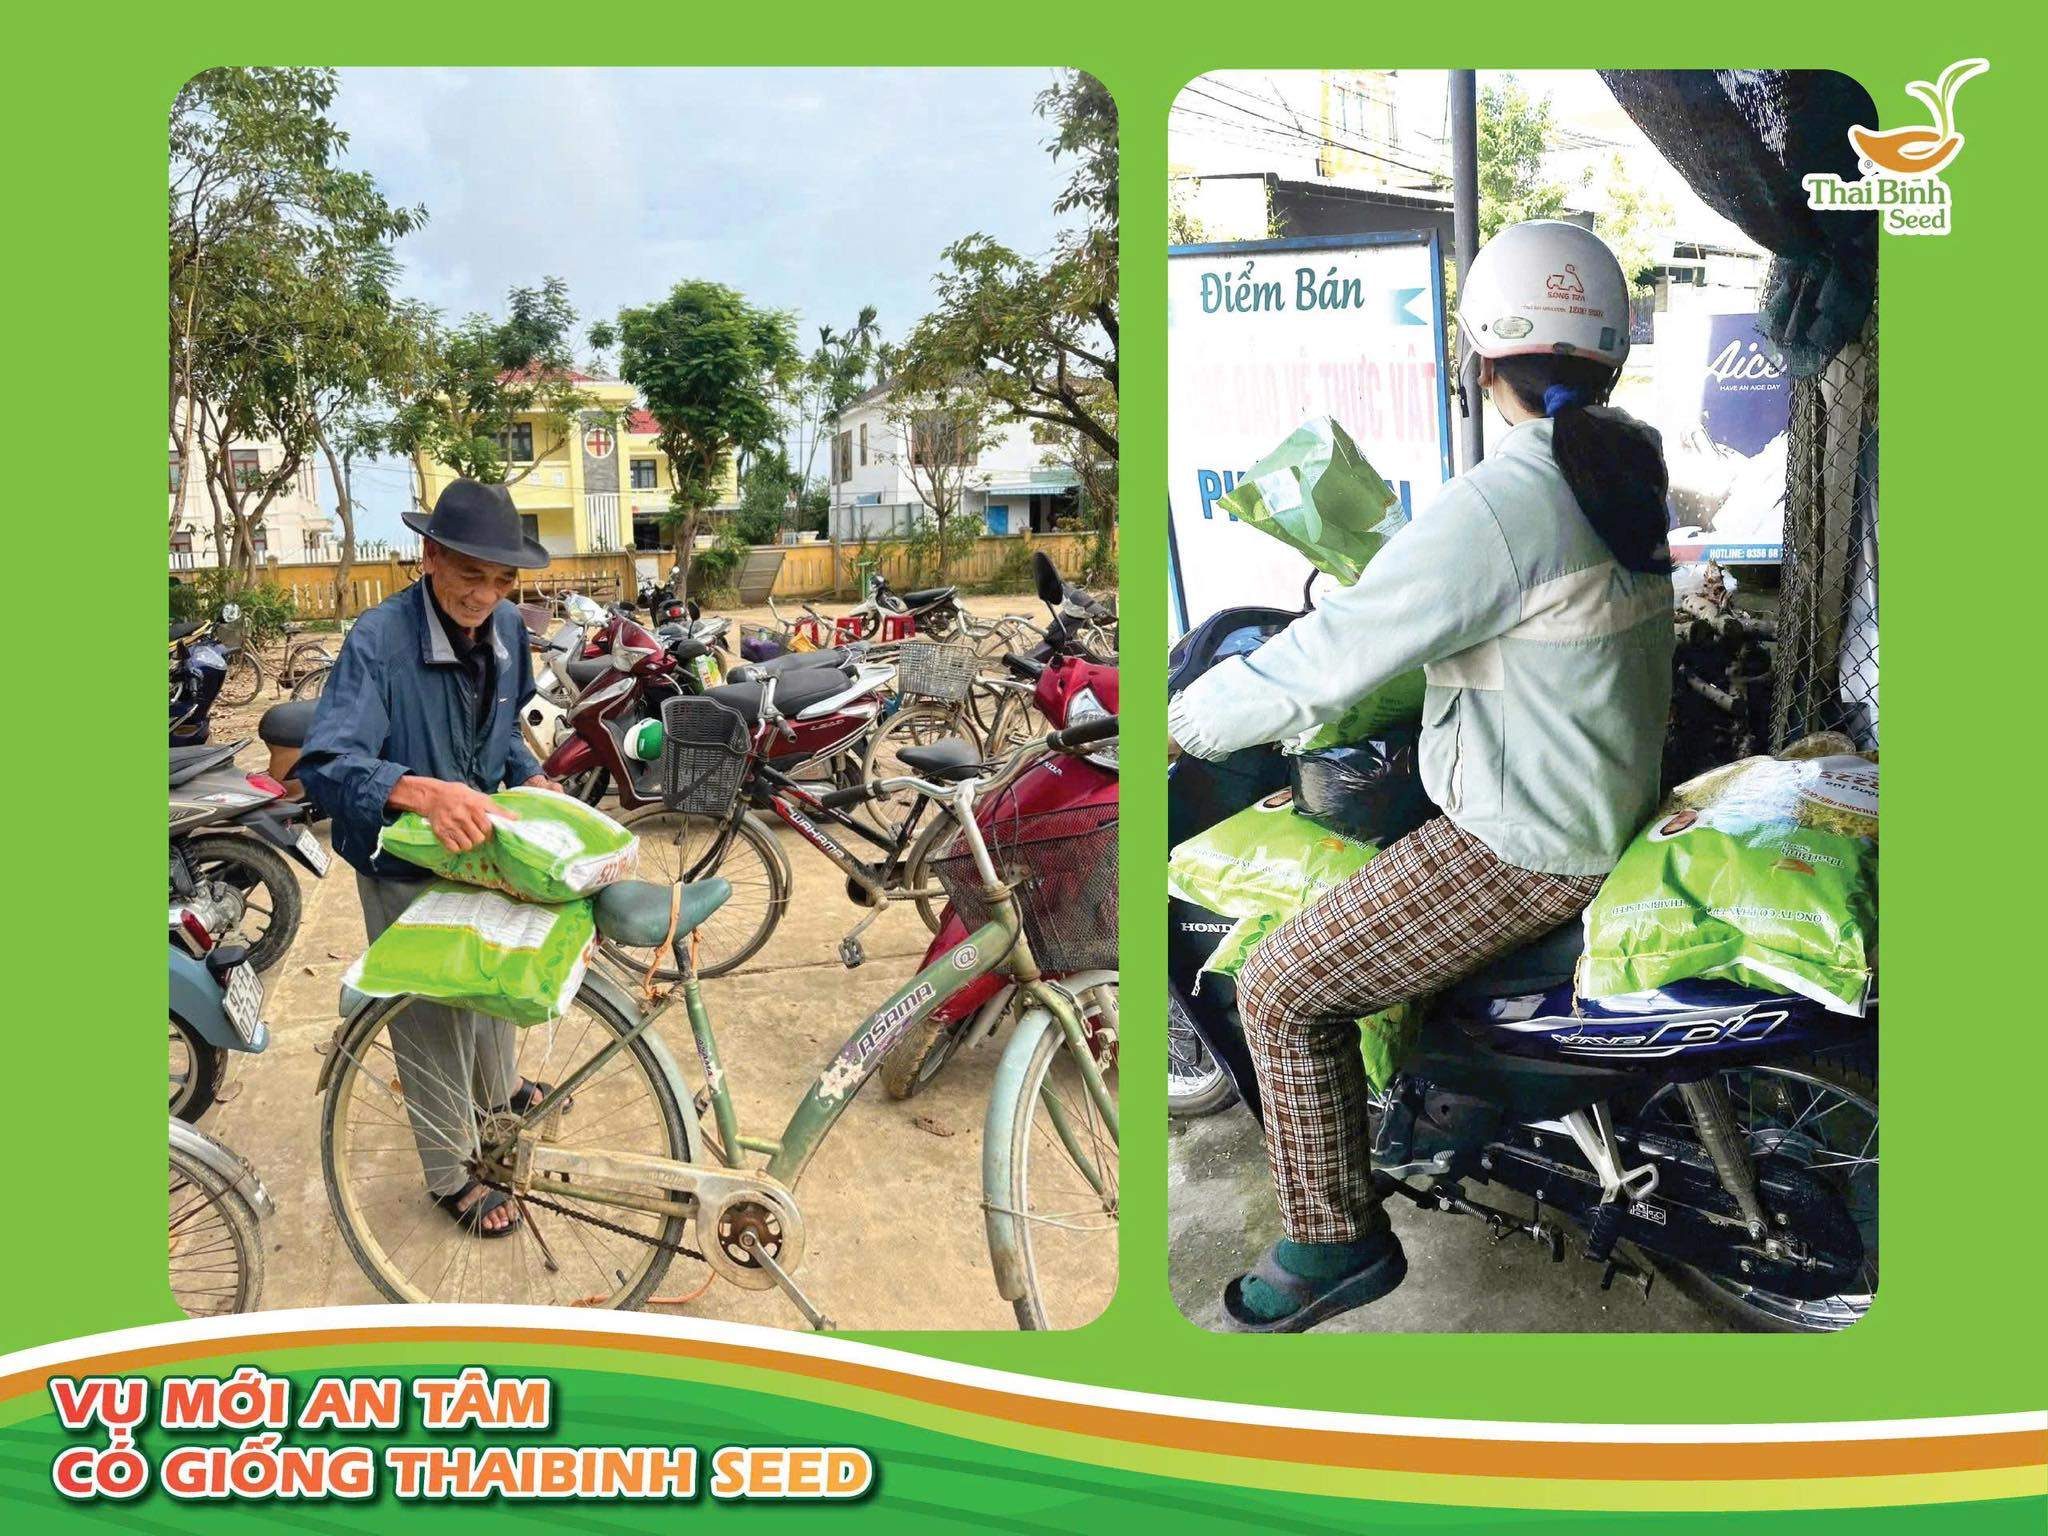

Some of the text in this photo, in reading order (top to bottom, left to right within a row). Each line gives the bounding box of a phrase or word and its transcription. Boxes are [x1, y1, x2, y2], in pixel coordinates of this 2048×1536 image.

[1200, 261, 1365, 314] Điểm Bán
[1720, 384, 1738, 392] HAVE
[1709, 549, 1745, 559] HOTLINE:
[1180, 922, 1232, 933] HOND
[858, 982, 936, 1059] ASAMA
